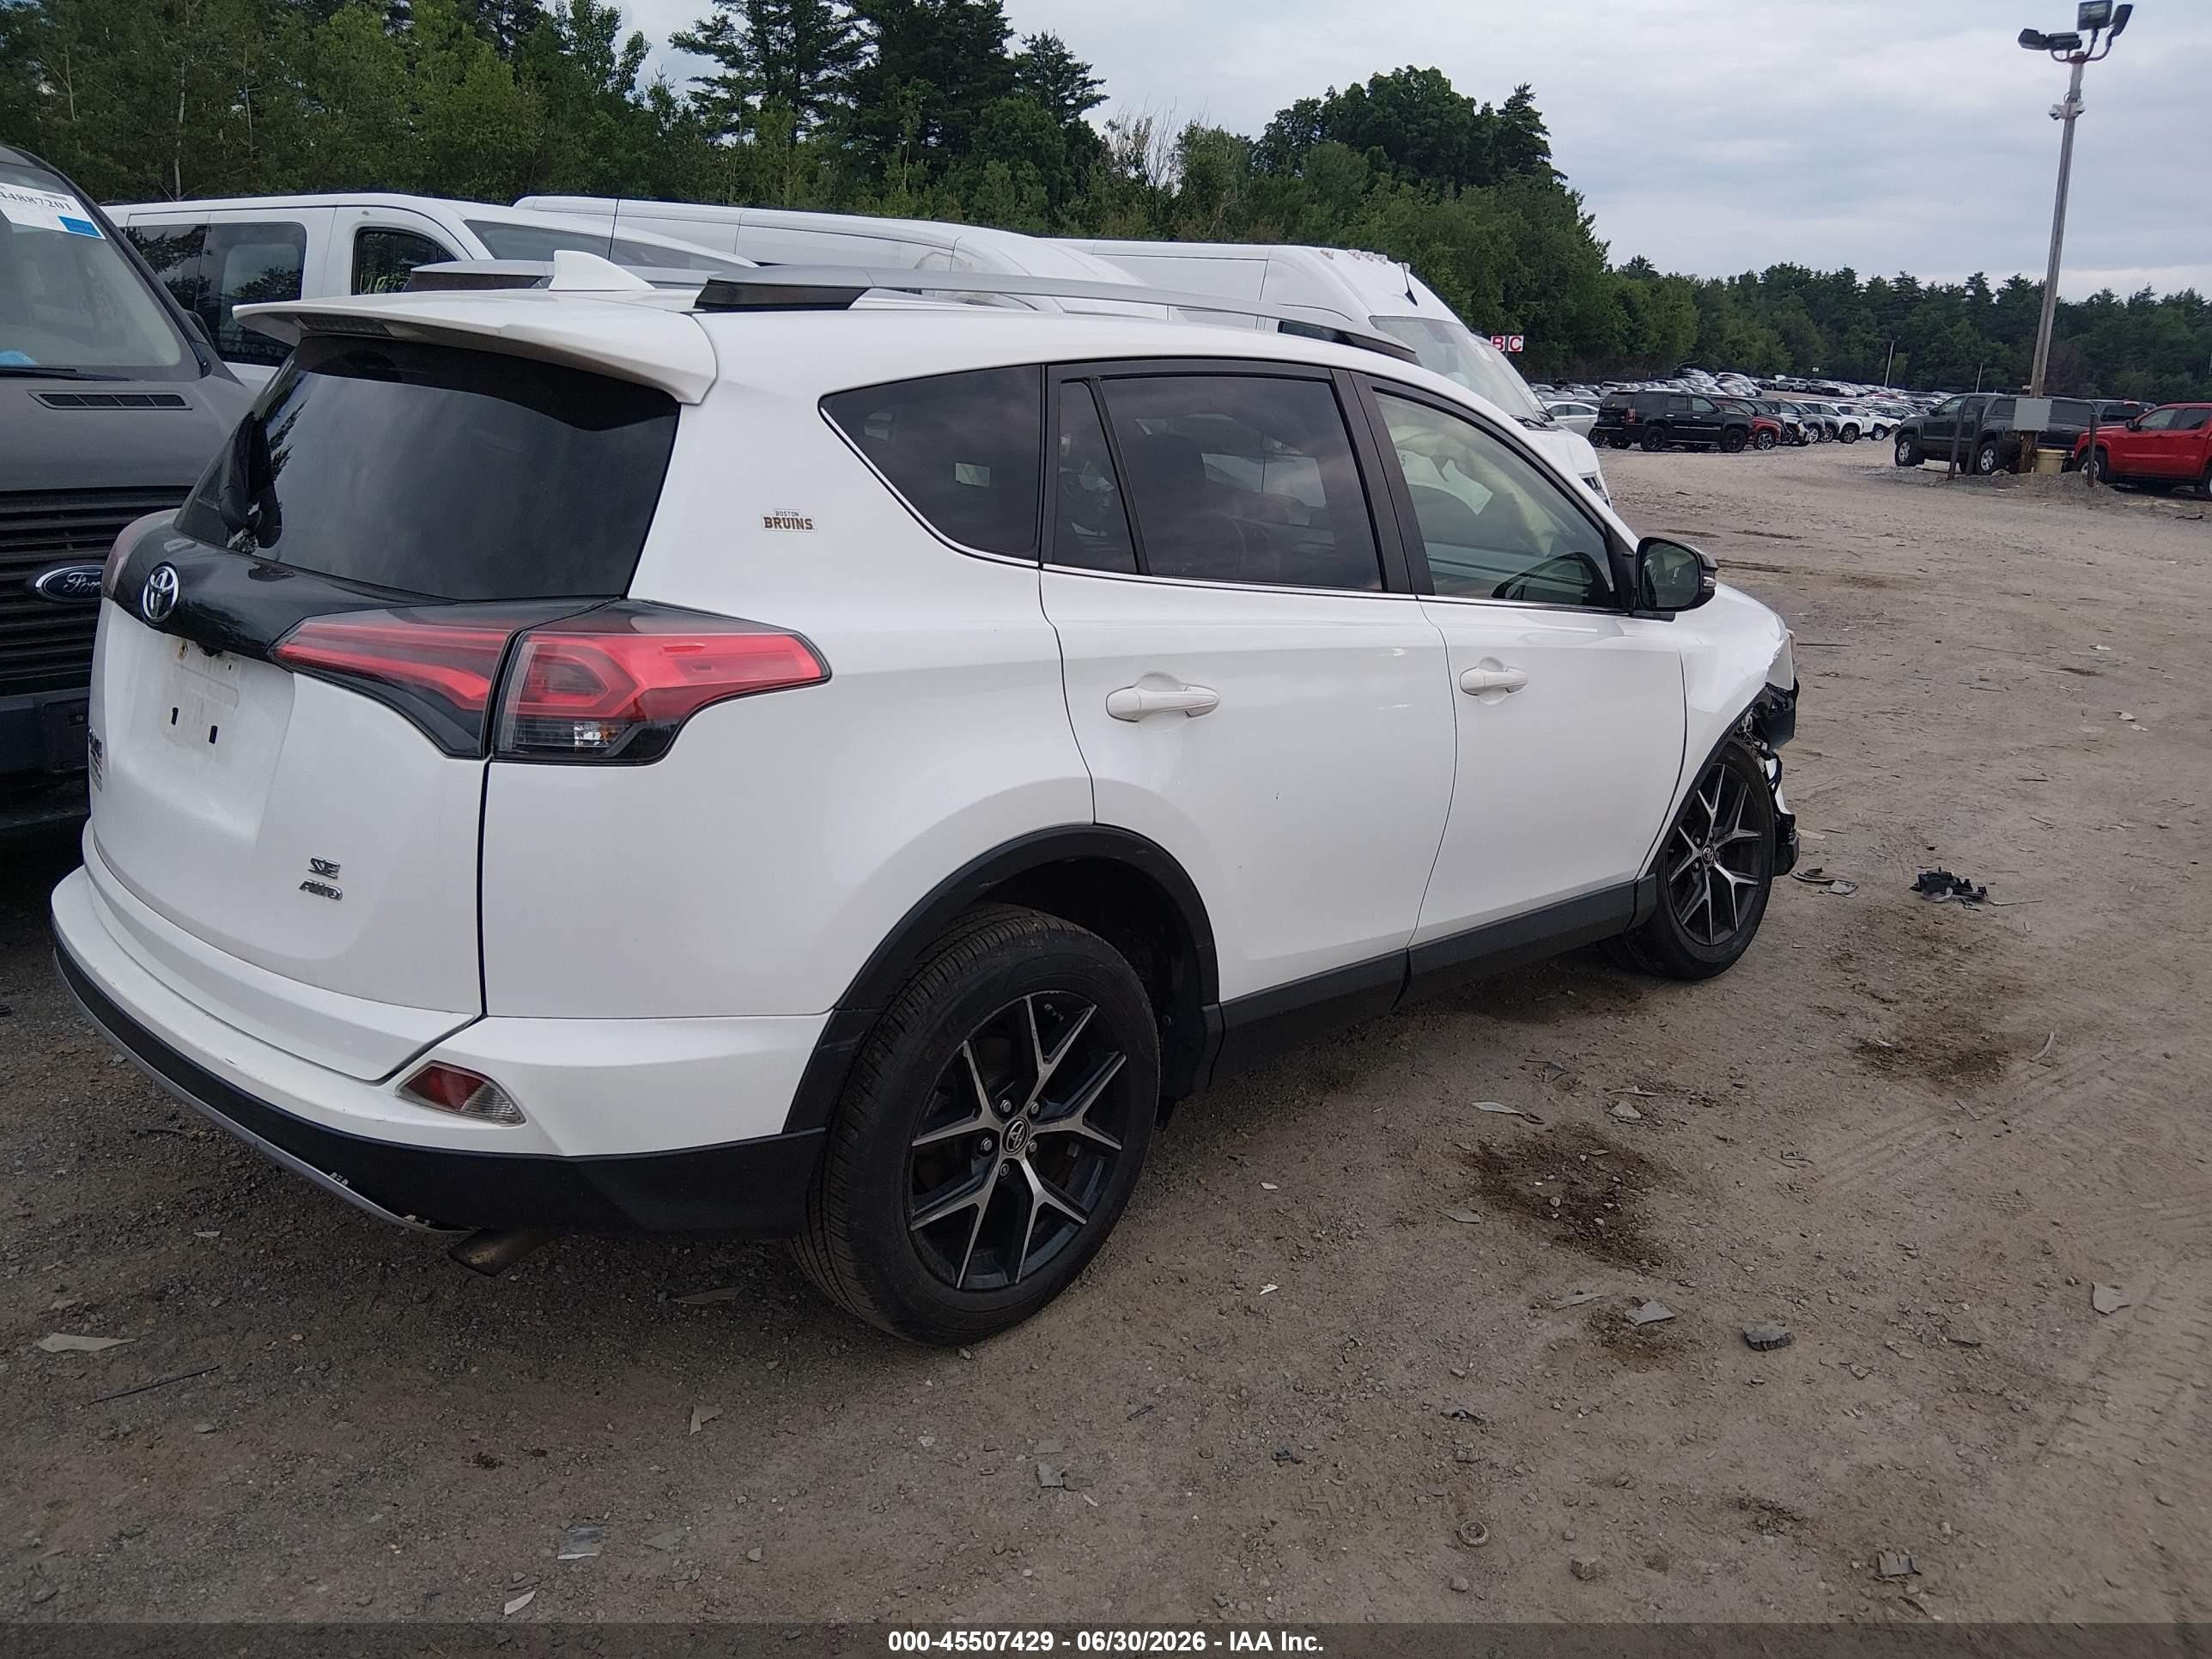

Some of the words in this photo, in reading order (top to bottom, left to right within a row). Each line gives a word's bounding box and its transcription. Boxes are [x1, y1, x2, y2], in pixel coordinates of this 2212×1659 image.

[1492, 337, 1504, 351] B
[1510, 337, 1522, 351] C
[763, 516, 814, 531] BRUINS
[63, 572, 101, 592] For
[308, 857, 341, 880] SE
